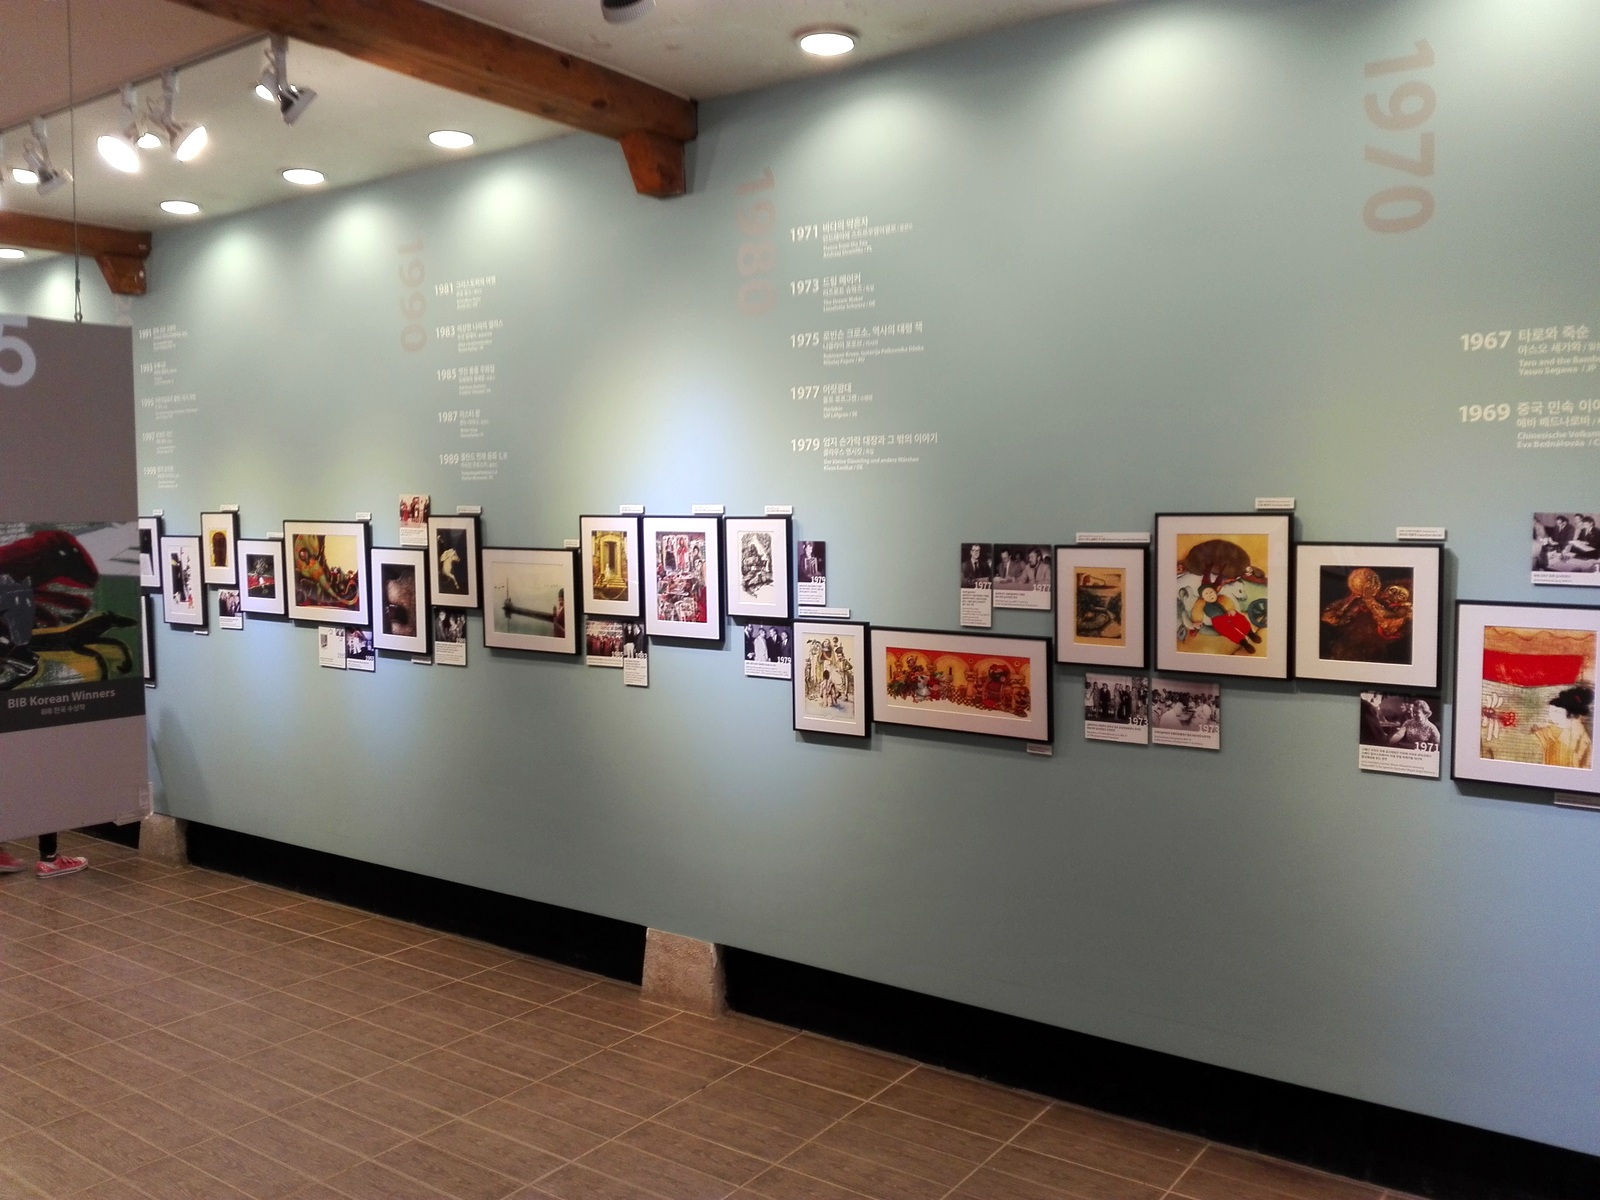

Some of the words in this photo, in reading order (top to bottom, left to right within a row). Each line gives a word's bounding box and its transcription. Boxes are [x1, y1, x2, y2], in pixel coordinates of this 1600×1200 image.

[1362, 37, 1437, 234] 1970
[790, 224, 818, 242] 1971
[736, 166, 777, 317] 1980
[790, 278, 819, 296] 1973
[791, 332, 819, 348] 1975
[1460, 330, 1512, 352] 1967
[0, 314, 36, 387] 5
[437, 368, 456, 380] 1985
[791, 385, 820, 400] 1977
[438, 410, 458, 422] 1987
[1460, 403, 1511, 423] 1969
[791, 438, 820, 452] 1979
[440, 453, 459, 466] 1989
[974, 582, 992, 590] 1977
[1032, 584, 1050, 592] 1977
[8, 698, 27, 708] BIB
[30, 694, 69, 706] Korean
[72, 690, 116, 701] Winners
[54, 706, 66, 714] 한국
[1128, 717, 1148, 726] 1973
[1199, 724, 1219, 734] 1973
[1414, 742, 1439, 752] 1971
